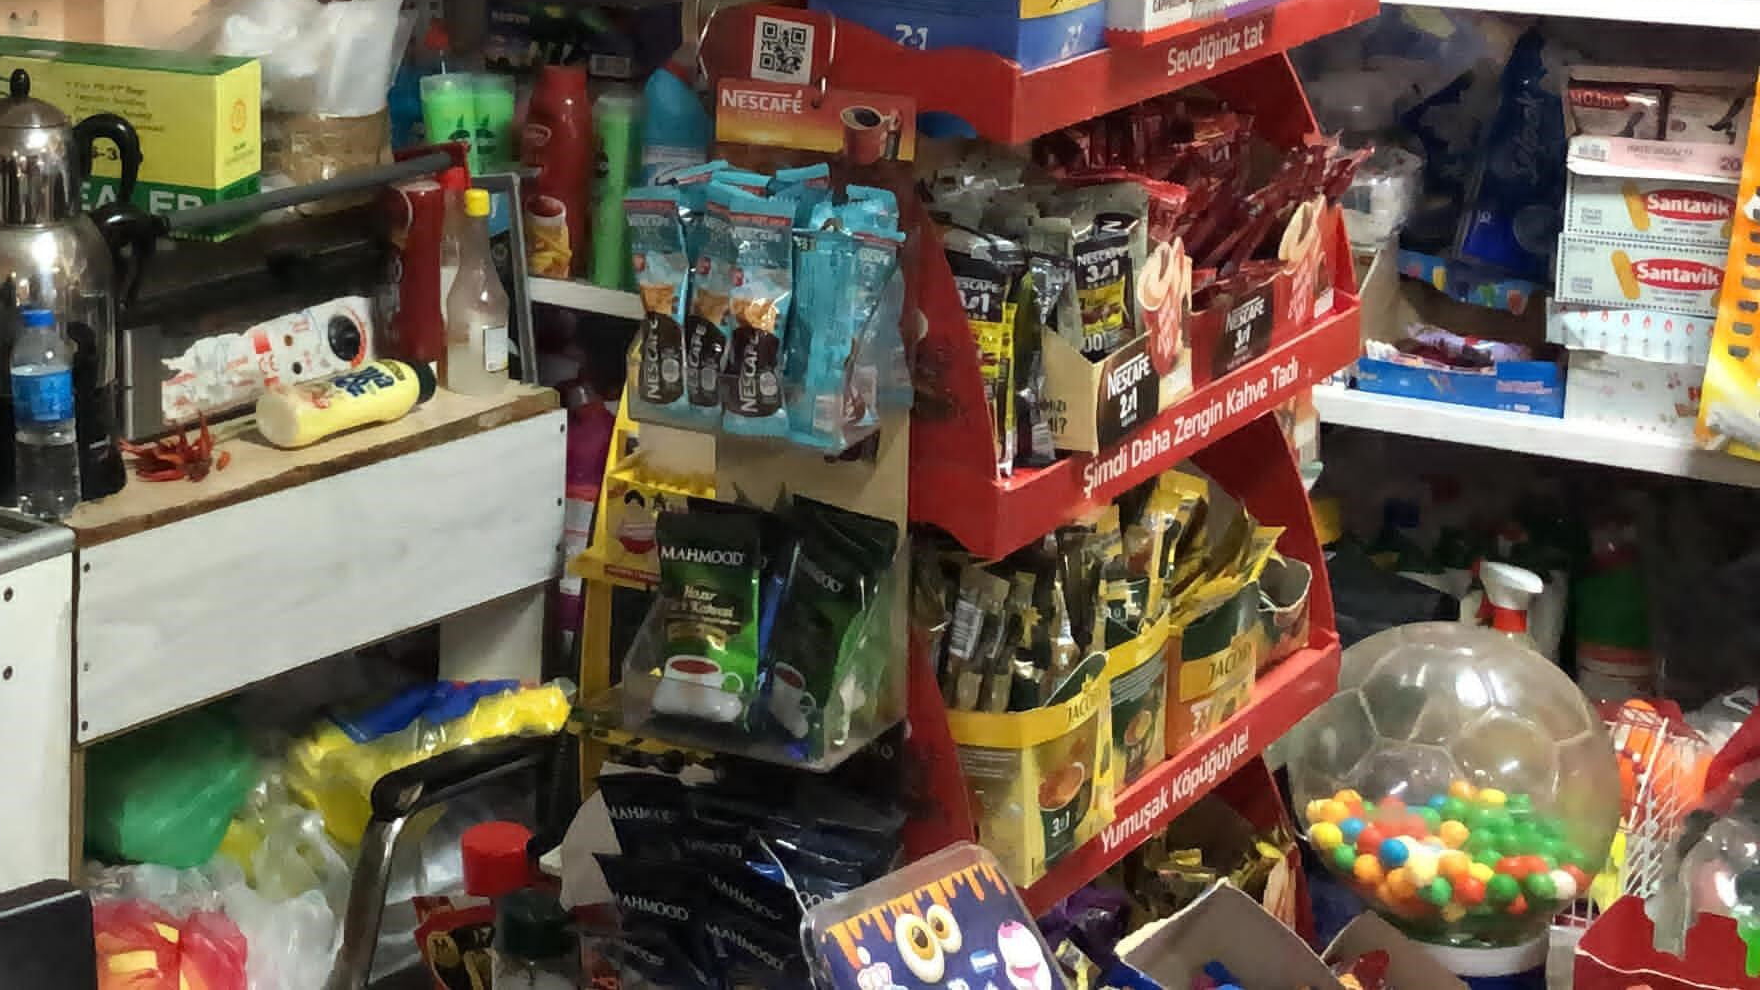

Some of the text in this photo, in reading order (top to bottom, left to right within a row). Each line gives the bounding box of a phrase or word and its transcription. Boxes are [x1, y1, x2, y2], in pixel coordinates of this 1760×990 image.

[1167, 19, 1265, 77] Sevdiğiniz tat
[720, 88, 803, 115] NESCAFÉ
[1647, 194, 1731, 218] Santavik
[1636, 262, 1721, 286] Santavik
[1082, 443, 1128, 500] Şimdi
[1131, 429, 1172, 469] Daha
[1174, 401, 1223, 447] Zengin
[1226, 377, 1268, 414] Kahve
[1270, 355, 1300, 391] Tadı
[660, 545, 745, 567] MAHMOOD
[1100, 725, 1250, 855] Yumuşak Köpüğüyle!
